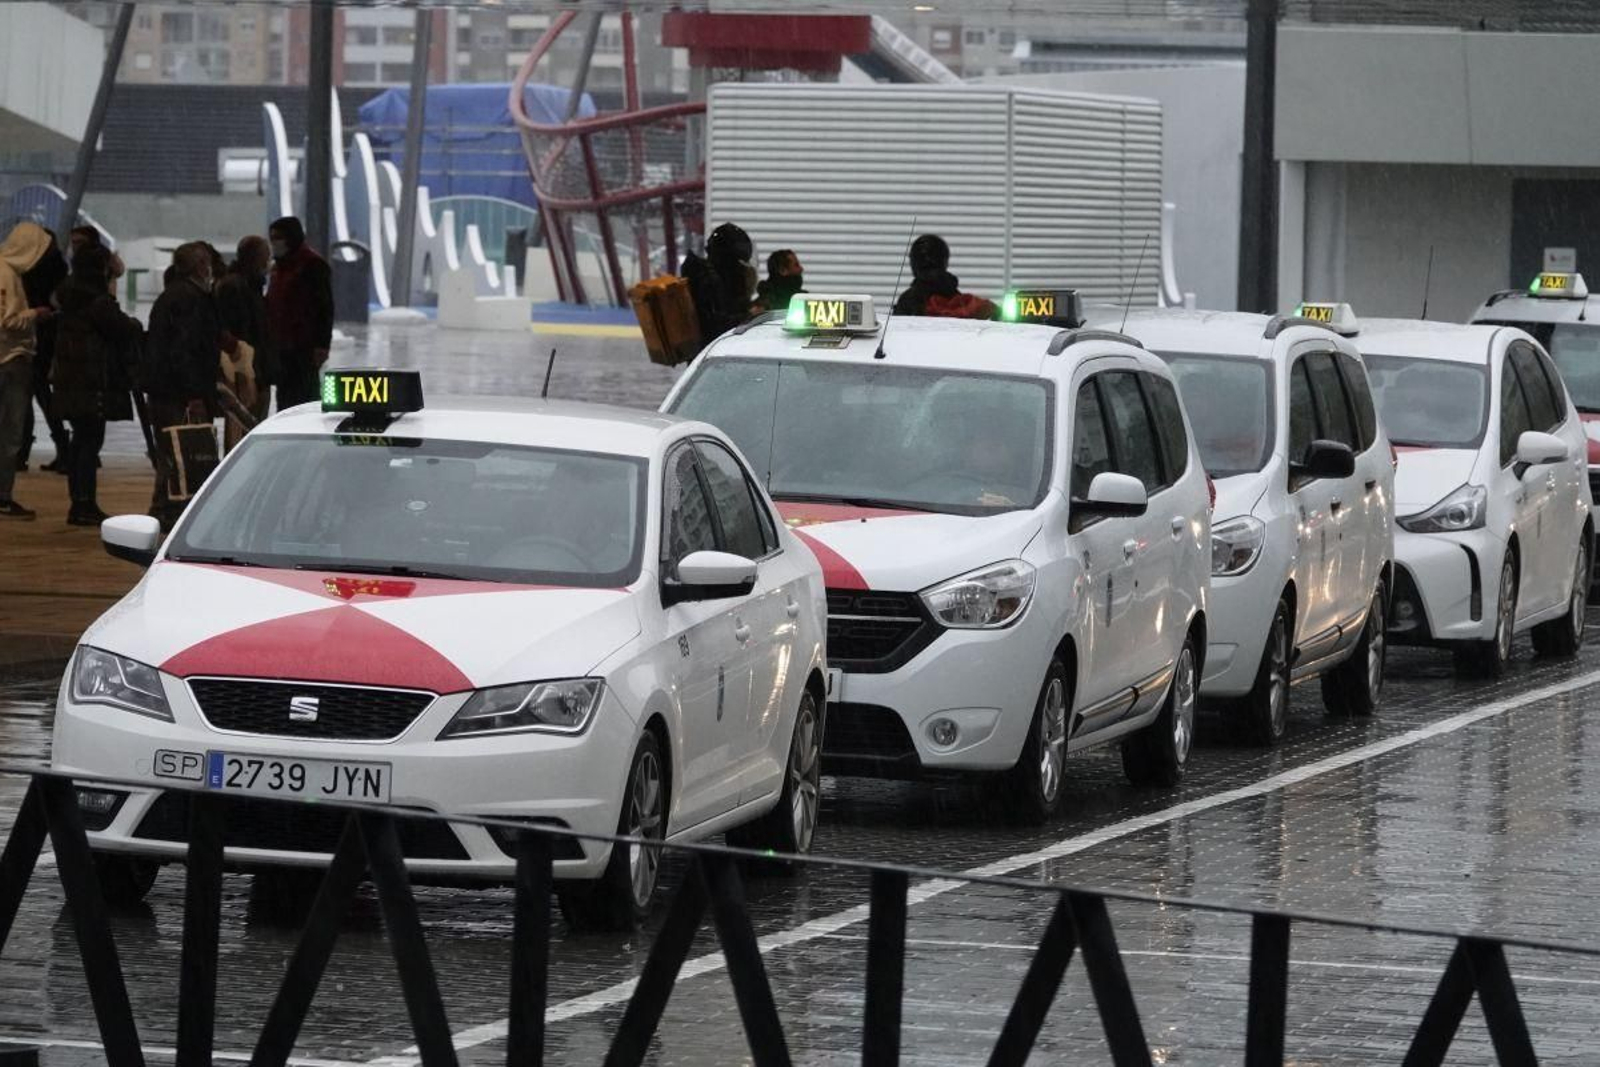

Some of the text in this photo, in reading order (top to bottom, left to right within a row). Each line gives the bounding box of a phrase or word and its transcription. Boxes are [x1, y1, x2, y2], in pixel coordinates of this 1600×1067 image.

[1541, 276, 1566, 288] TAXI
[808, 301, 845, 324] TAXI
[1017, 297, 1054, 316] TAXI
[1303, 307, 1333, 322] TAXI
[340, 376, 389, 403] TAXI
[160, 753, 199, 775] SP
[225, 758, 382, 798] 2739 JYN
